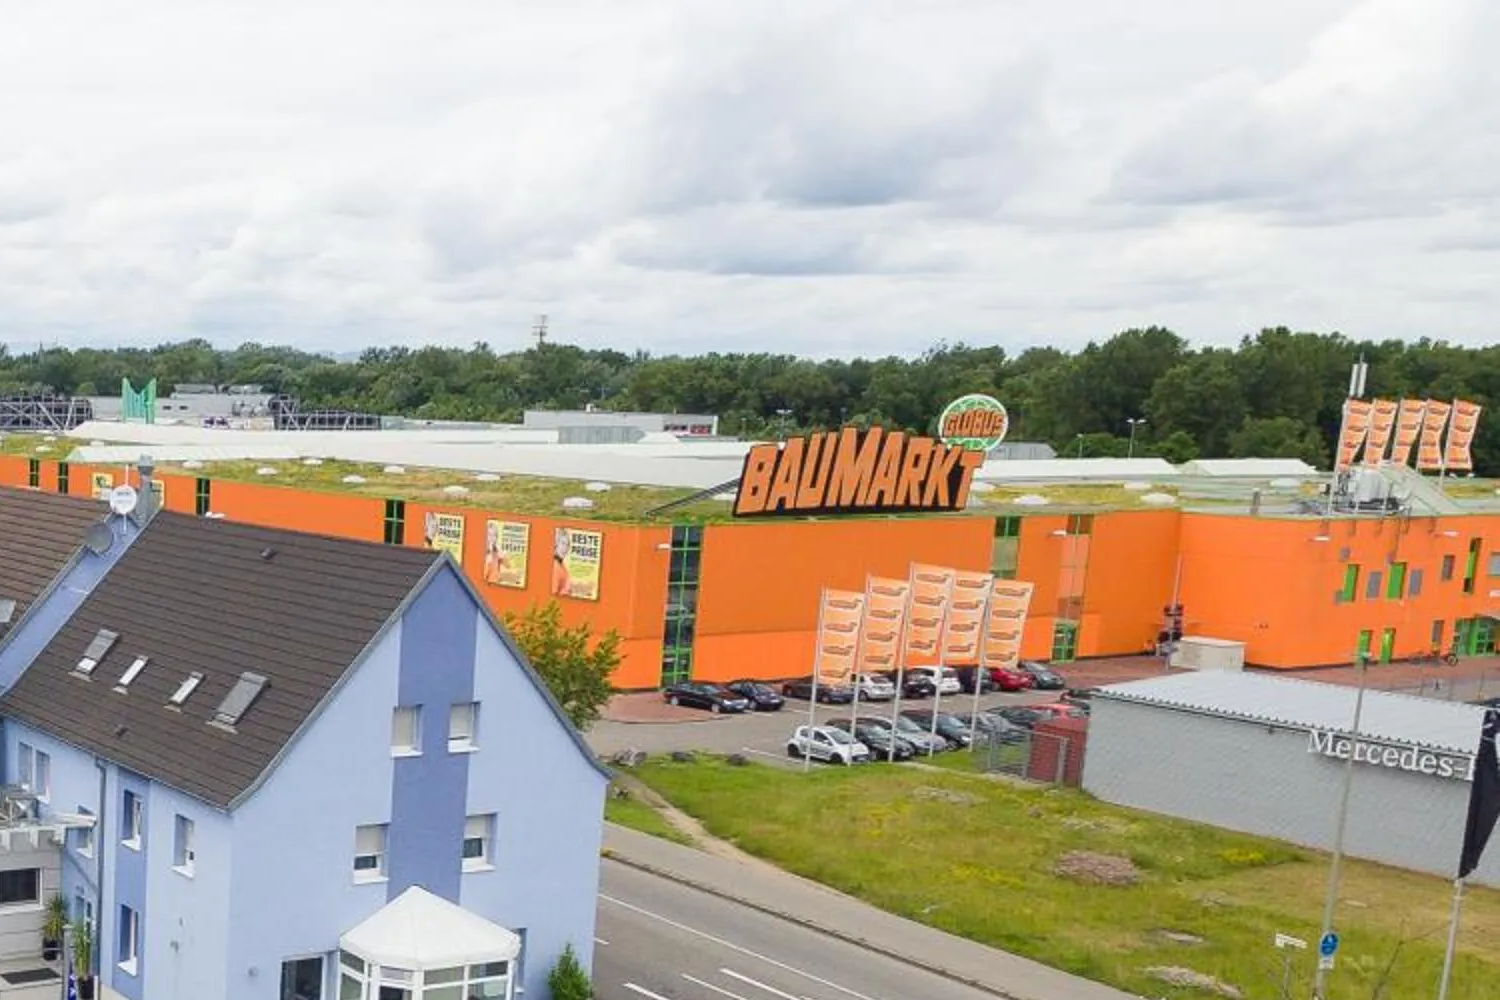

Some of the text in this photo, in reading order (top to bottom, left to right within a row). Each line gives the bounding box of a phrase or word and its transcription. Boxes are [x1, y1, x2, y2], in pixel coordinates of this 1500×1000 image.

[943, 408, 1005, 438] GLOBUS
[732, 424, 986, 517] BAUMARKT
[571, 532, 599, 547] BESTE
[571, 545, 599, 559] PREISE
